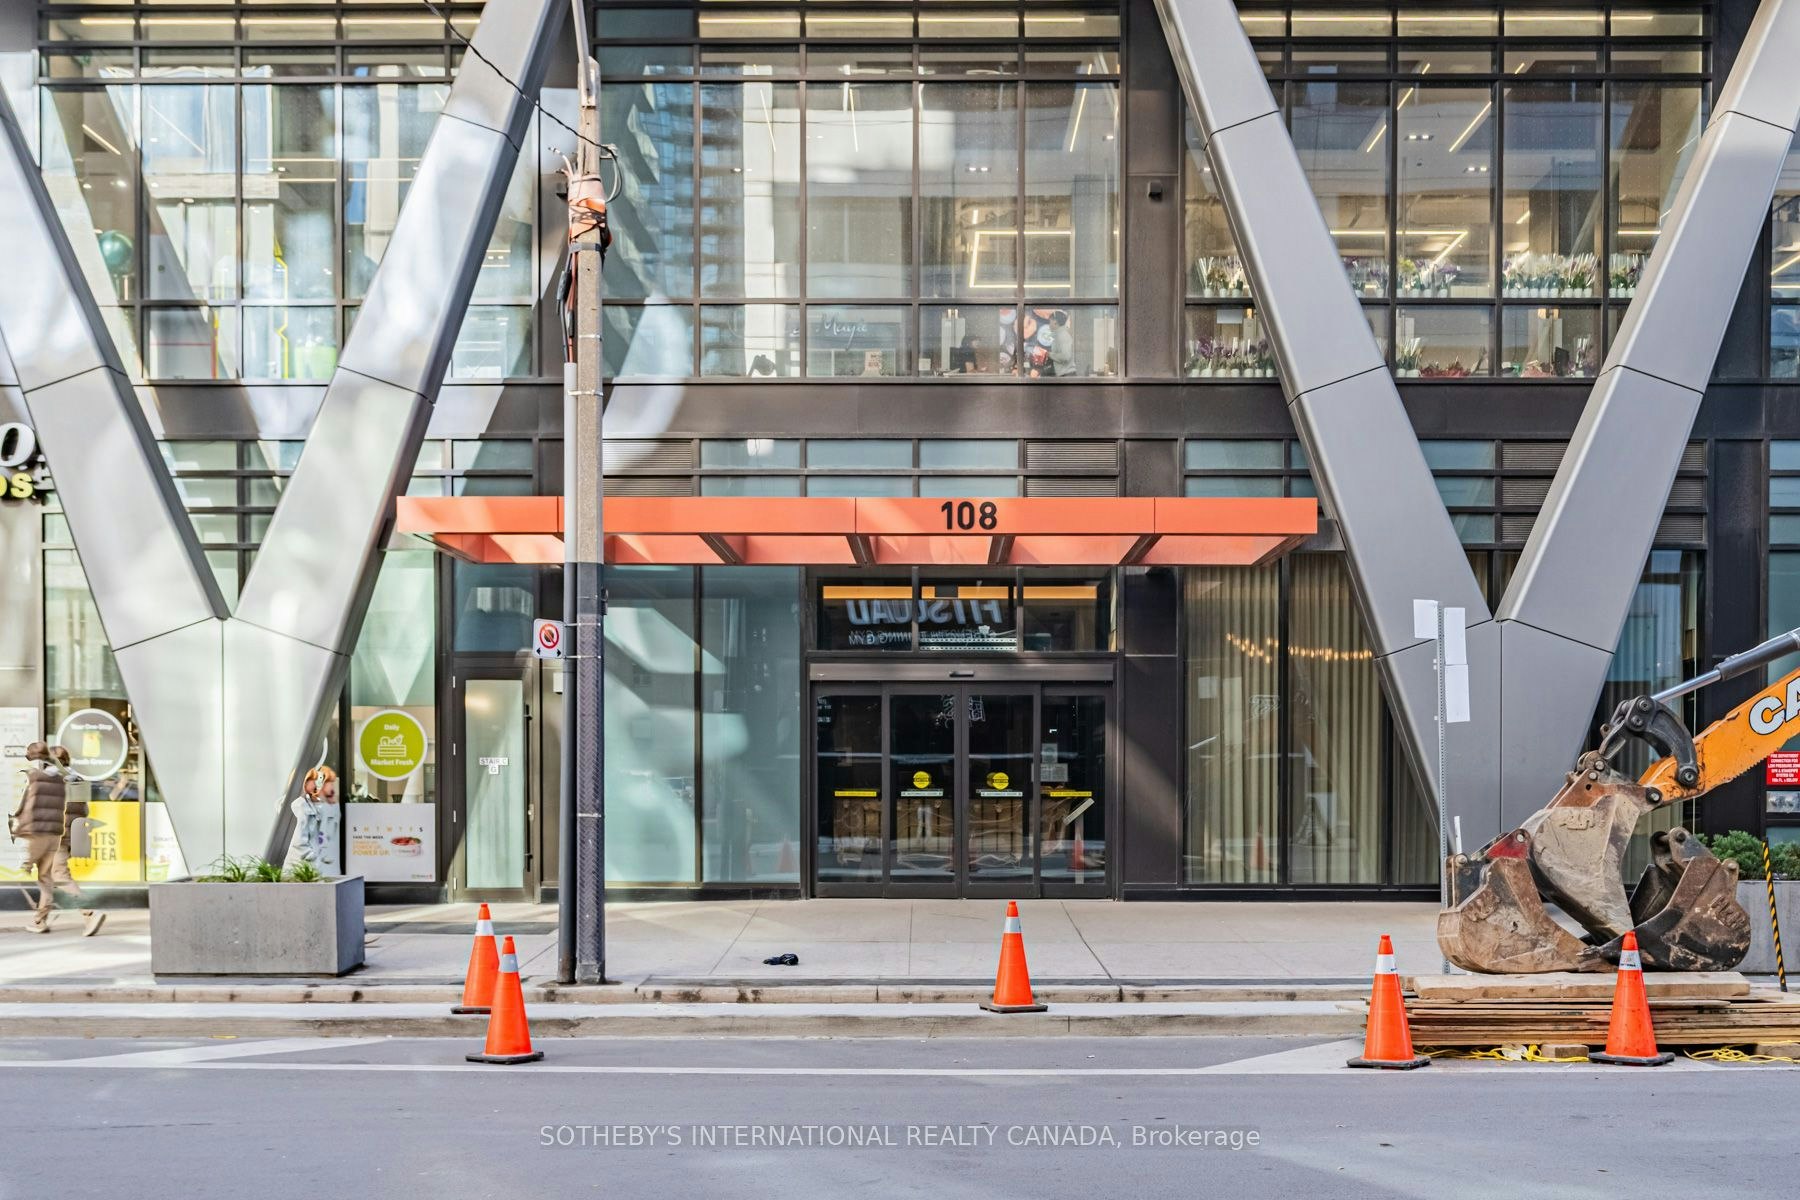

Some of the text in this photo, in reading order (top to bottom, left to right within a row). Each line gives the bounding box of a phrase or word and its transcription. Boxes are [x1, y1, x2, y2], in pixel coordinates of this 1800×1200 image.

[941, 501, 997, 530] 108
[384, 723, 399, 731] Daily
[371, 758, 394, 766] Market
[92, 847, 118, 861] TEA
